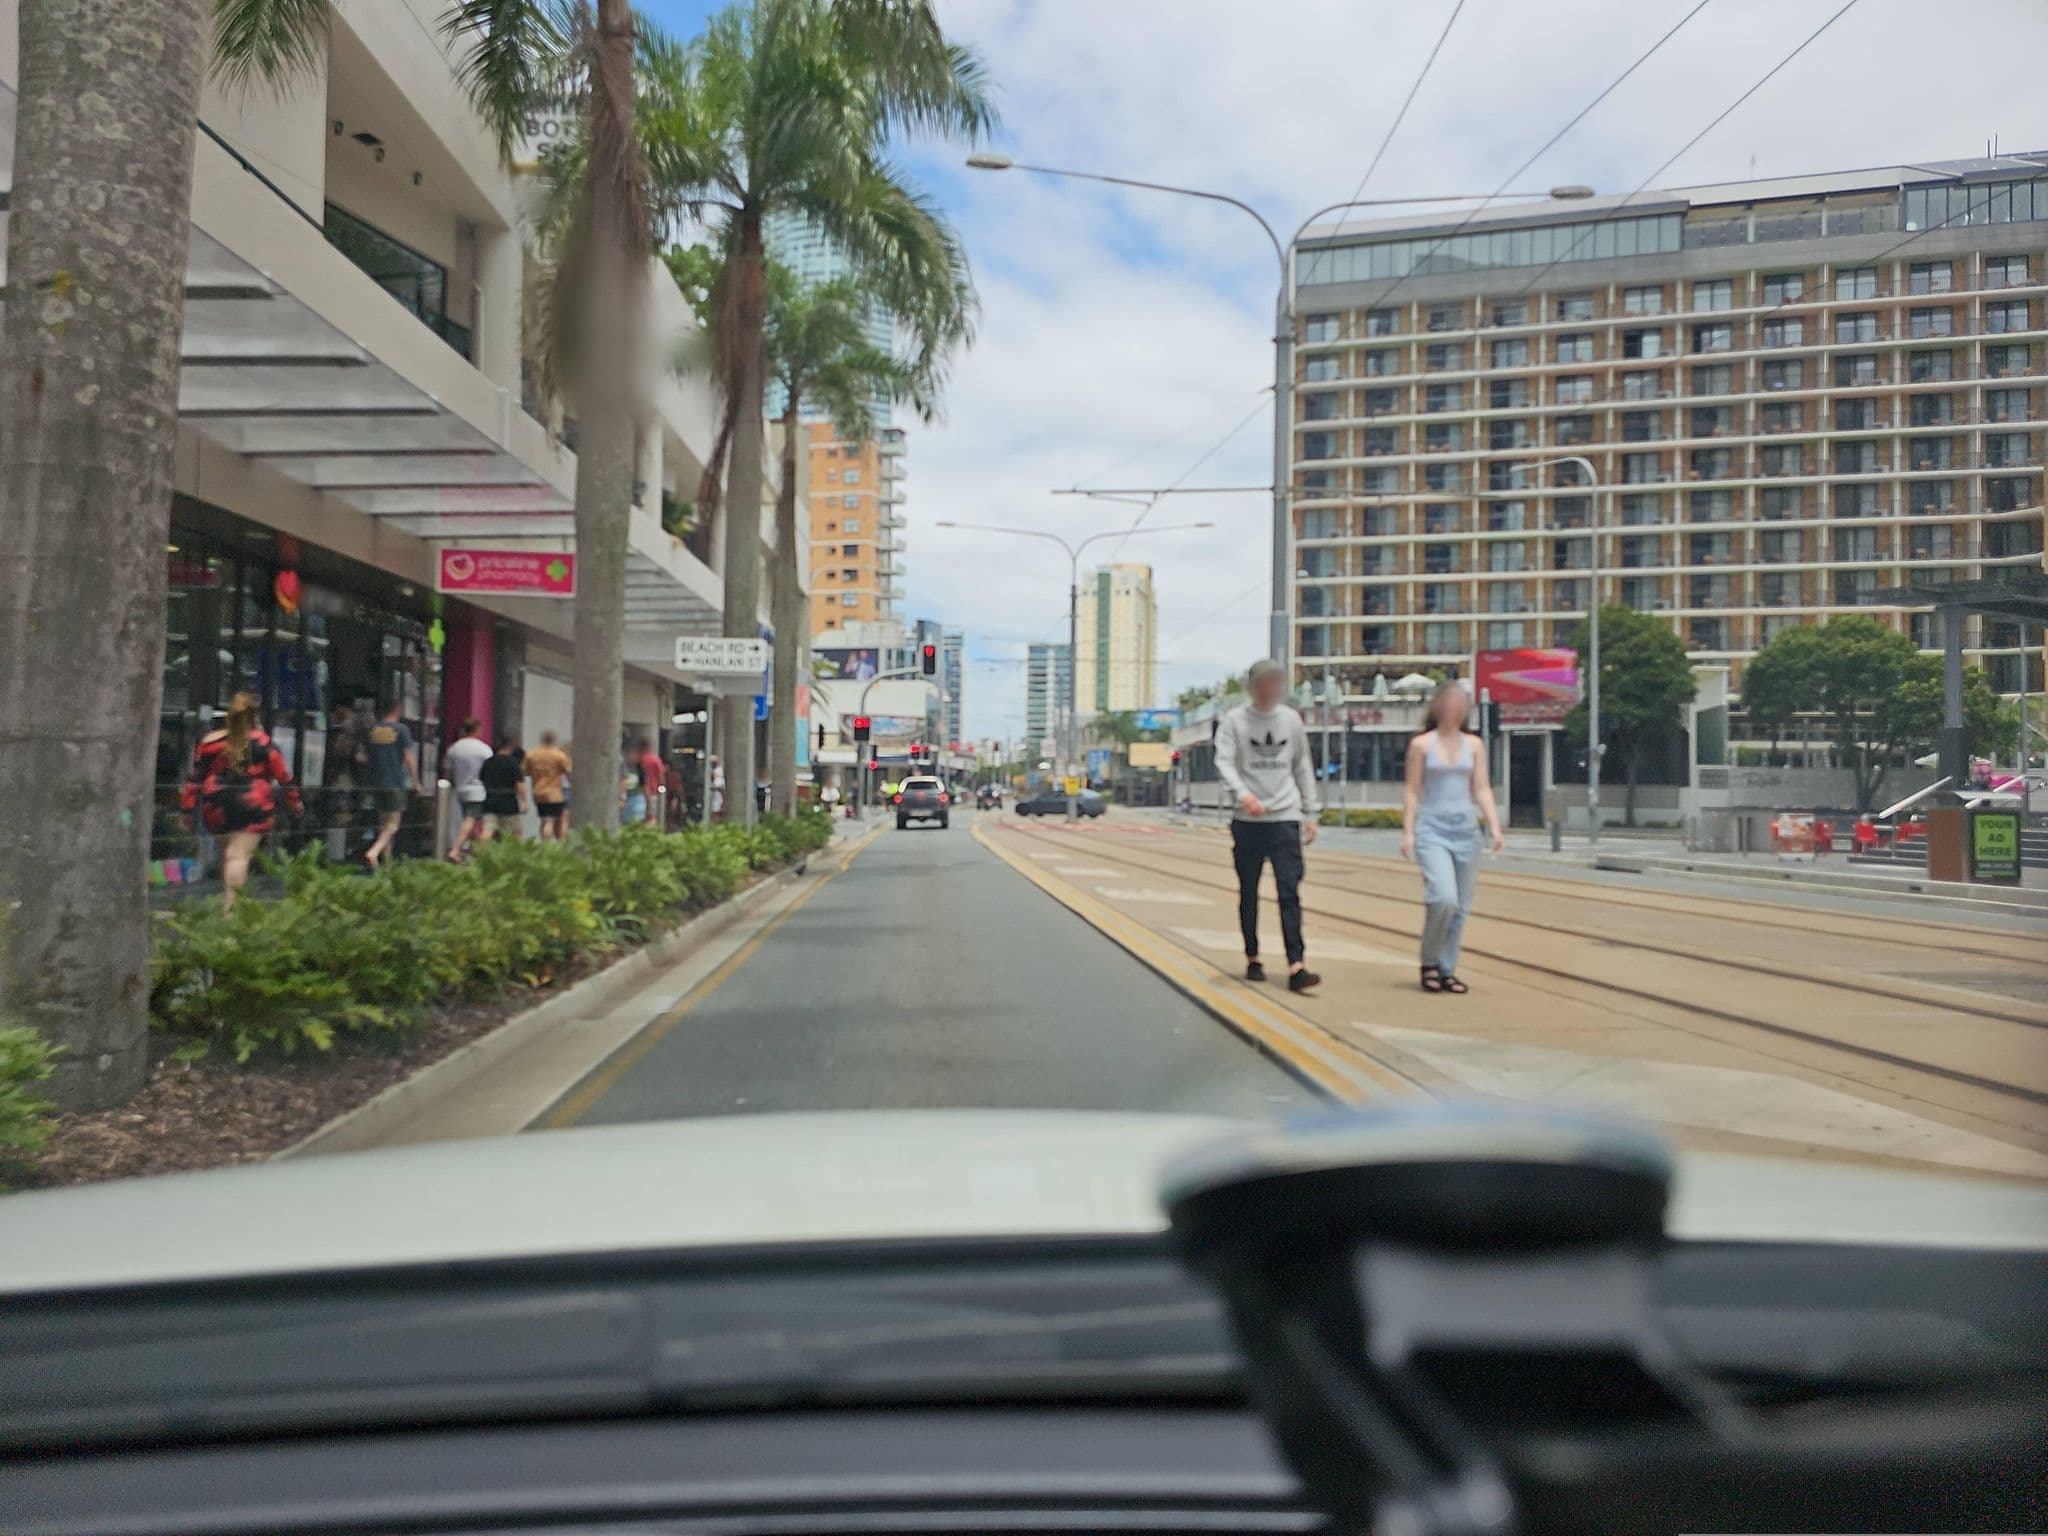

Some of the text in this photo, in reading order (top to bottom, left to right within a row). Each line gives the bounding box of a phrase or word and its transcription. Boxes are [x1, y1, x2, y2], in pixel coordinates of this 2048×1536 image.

[681, 641, 747, 654] BEACH RD
[1980, 820, 2012, 829] YOUR
[1987, 833, 2006, 842] AD
[1979, 847, 2012, 856] HERE
